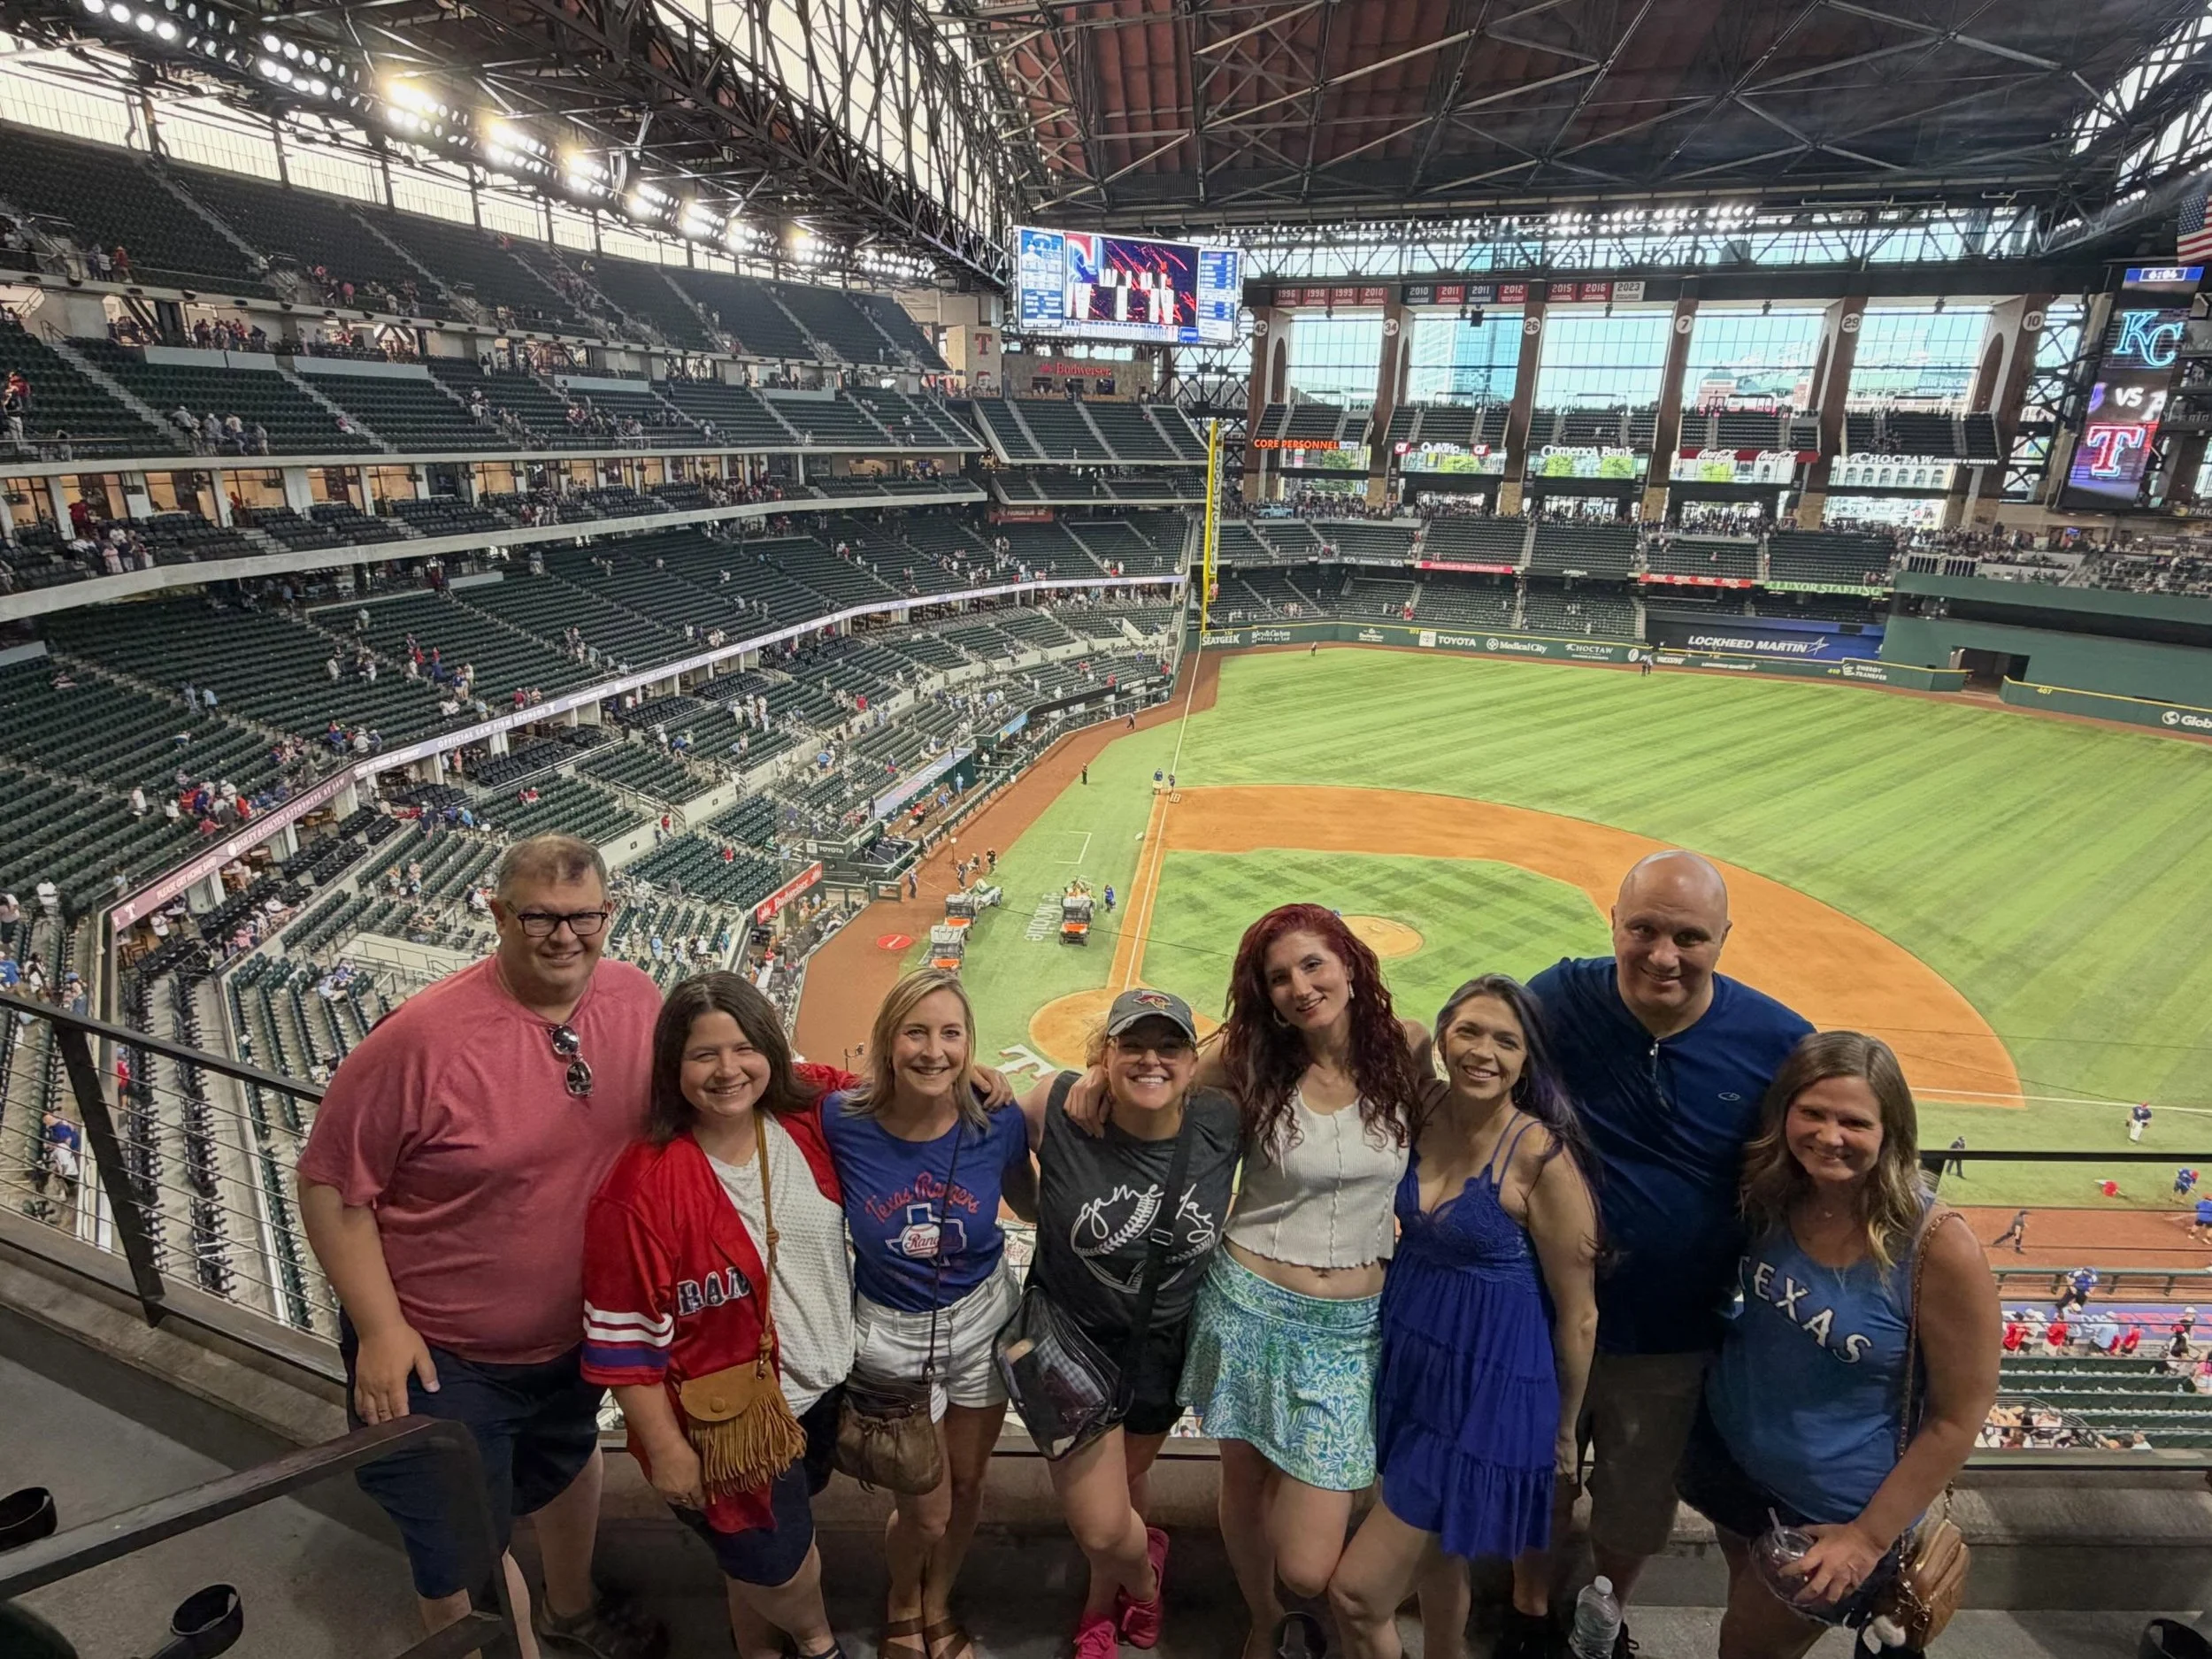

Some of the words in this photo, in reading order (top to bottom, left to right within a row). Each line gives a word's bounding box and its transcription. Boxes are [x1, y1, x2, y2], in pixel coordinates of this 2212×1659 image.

[1335, 288, 1354, 296] 1999
[1364, 288, 1384, 296] 2010
[1409, 287, 1429, 296] 2010
[1441, 286, 1459, 296] 2011
[1471, 286, 1490, 295] 2011
[1503, 285, 1523, 294] 2012
[1551, 284, 1572, 293] 2015
[1585, 283, 1606, 293] 2016
[1617, 282, 1640, 292] 2023
[1525, 321, 1539, 331] 26
[1680, 319, 1689, 330] 7
[1843, 317, 1860, 329] 29
[2026, 314, 2041, 326] 10
[1255, 324, 1267, 334] 42
[1384, 323, 1397, 332] 34
[975, 333, 993, 356] T
[2112, 311, 2185, 367] KC
[1056, 362, 1111, 376] Budweiser
[2116, 387, 2144, 407] VS
[1254, 439, 1279, 449] CORE
[1281, 440, 1339, 450] PERSONNEL
[1420, 442, 1460, 455] QuikTrip
[1540, 445, 1598, 457] Comerica
[1600, 446, 1635, 457] Bank
[2087, 426, 2145, 477] T
[1858, 452, 1934, 465] CHOCTAW
[1776, 580, 1817, 593] LUXOR
[1820, 584, 1881, 596] STAFFING
[1202, 634, 1240, 646] SEATGEEK
[1438, 635, 1476, 647] TOYOTA
[1688, 635, 1755, 649] LOCKHEED
[1755, 640, 1809, 654] MARTIN
[1500, 641, 1528, 652] Medical
[1529, 643, 1548, 655] City
[1570, 643, 1613, 654] CHOCTAW
[1855, 672, 1887, 680] TRANSFER
[437, 732, 473, 748] OFFICIAL
[475, 726, 492, 739] LAW
[157, 882, 176, 900] PLEASE
[774, 879, 810, 907] Budweiser
[865, 1187, 912, 1224] Texas
[1081, 1184, 1164, 1239] game
